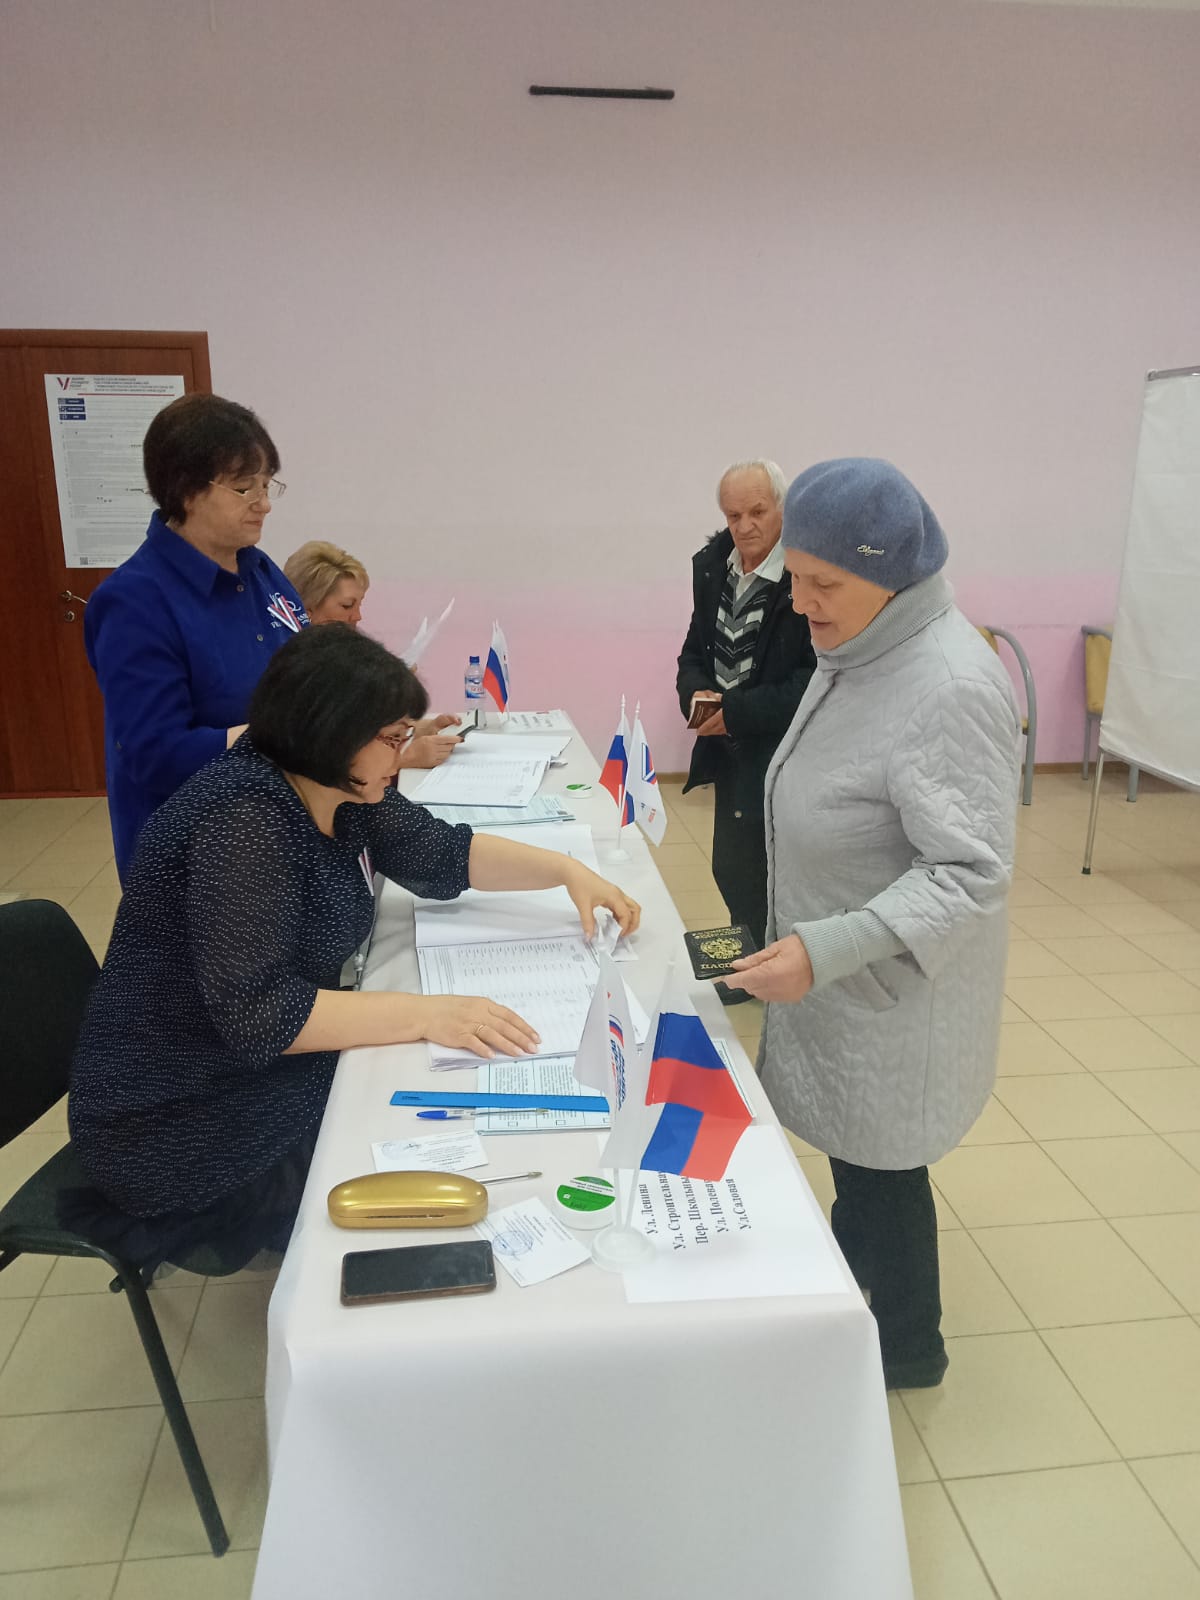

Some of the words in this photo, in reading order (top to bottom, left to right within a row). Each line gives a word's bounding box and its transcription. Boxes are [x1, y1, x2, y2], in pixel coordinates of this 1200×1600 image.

[700, 962, 733, 970] ПАСП
[639, 1183, 653, 1216] Ленина
[681, 1177, 702, 1221] Школьны
[646, 1214, 658, 1235] Ул.
[695, 1222, 709, 1244] Пер.
[715, 1217, 729, 1233] Ул.
[672, 1233, 686, 1250] Ул.
